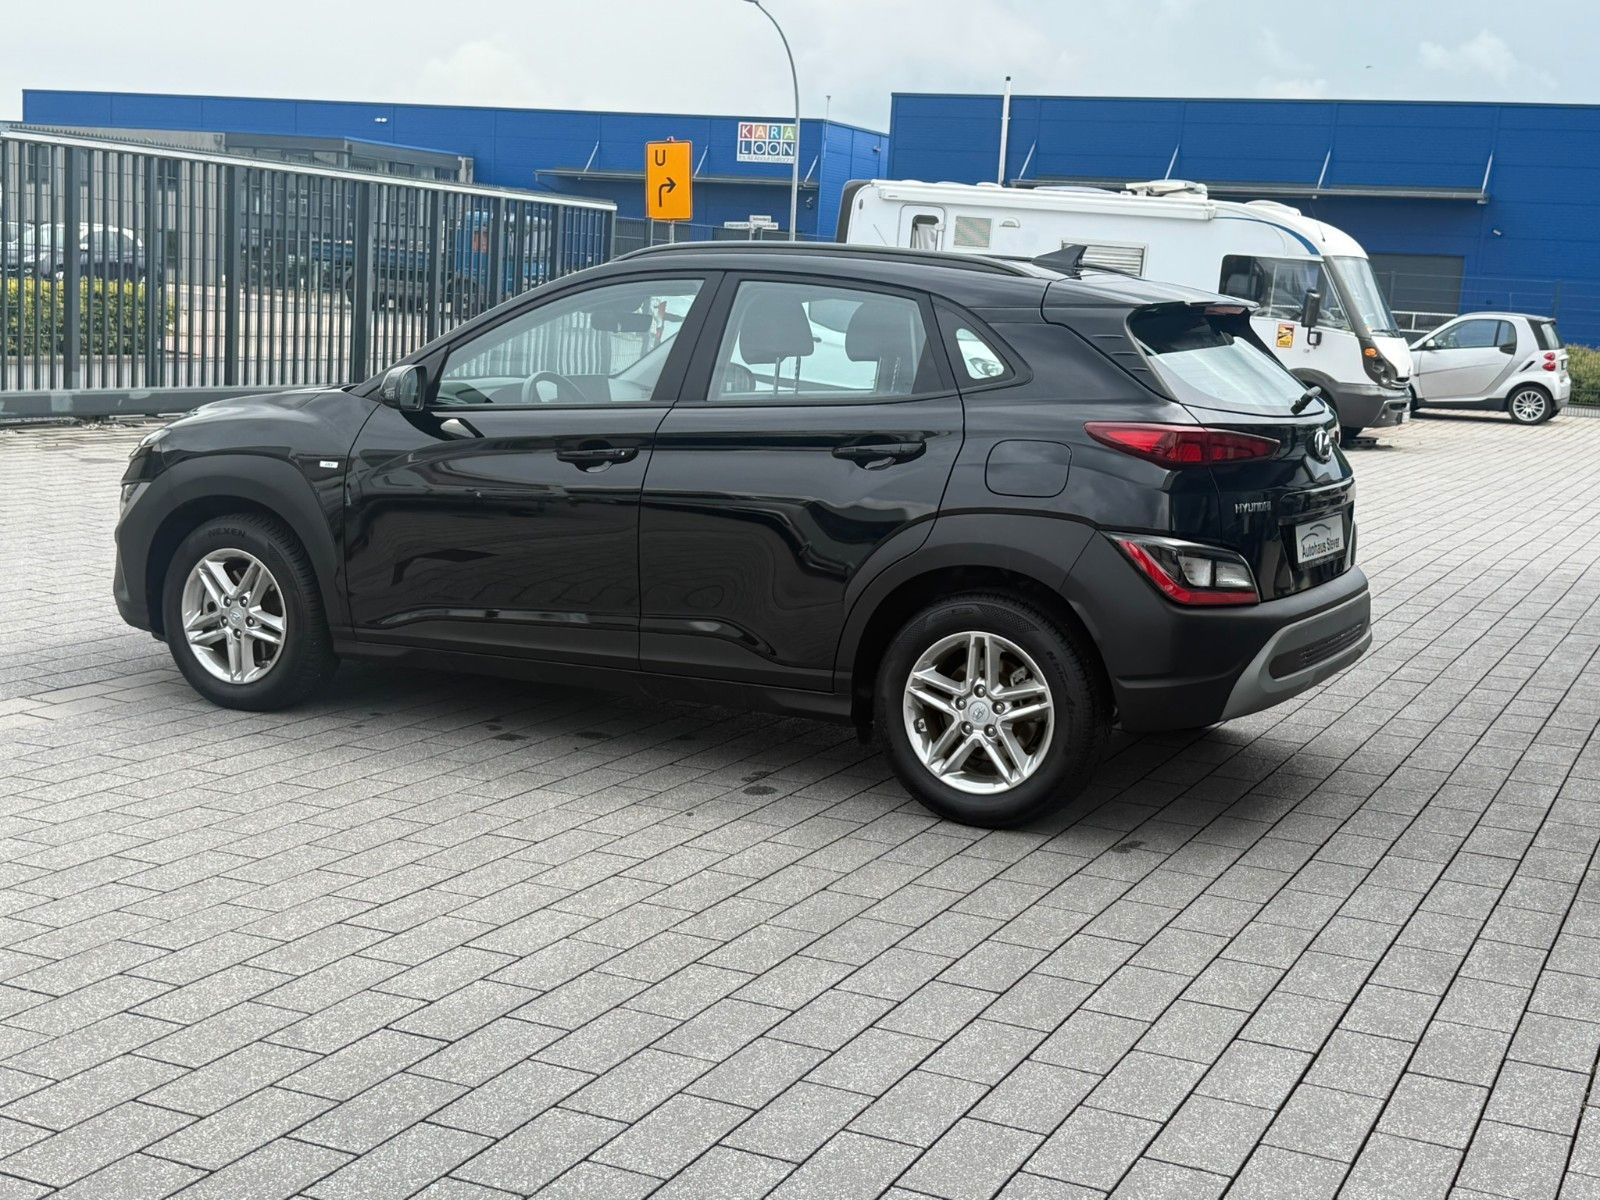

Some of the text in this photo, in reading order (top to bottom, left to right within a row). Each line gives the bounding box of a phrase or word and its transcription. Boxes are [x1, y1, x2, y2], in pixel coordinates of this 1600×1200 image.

[741, 125, 795, 140] KARA
[741, 141, 794, 156] LOON
[655, 149, 666, 167] U
[1235, 501, 1272, 514] HYUNDAI
